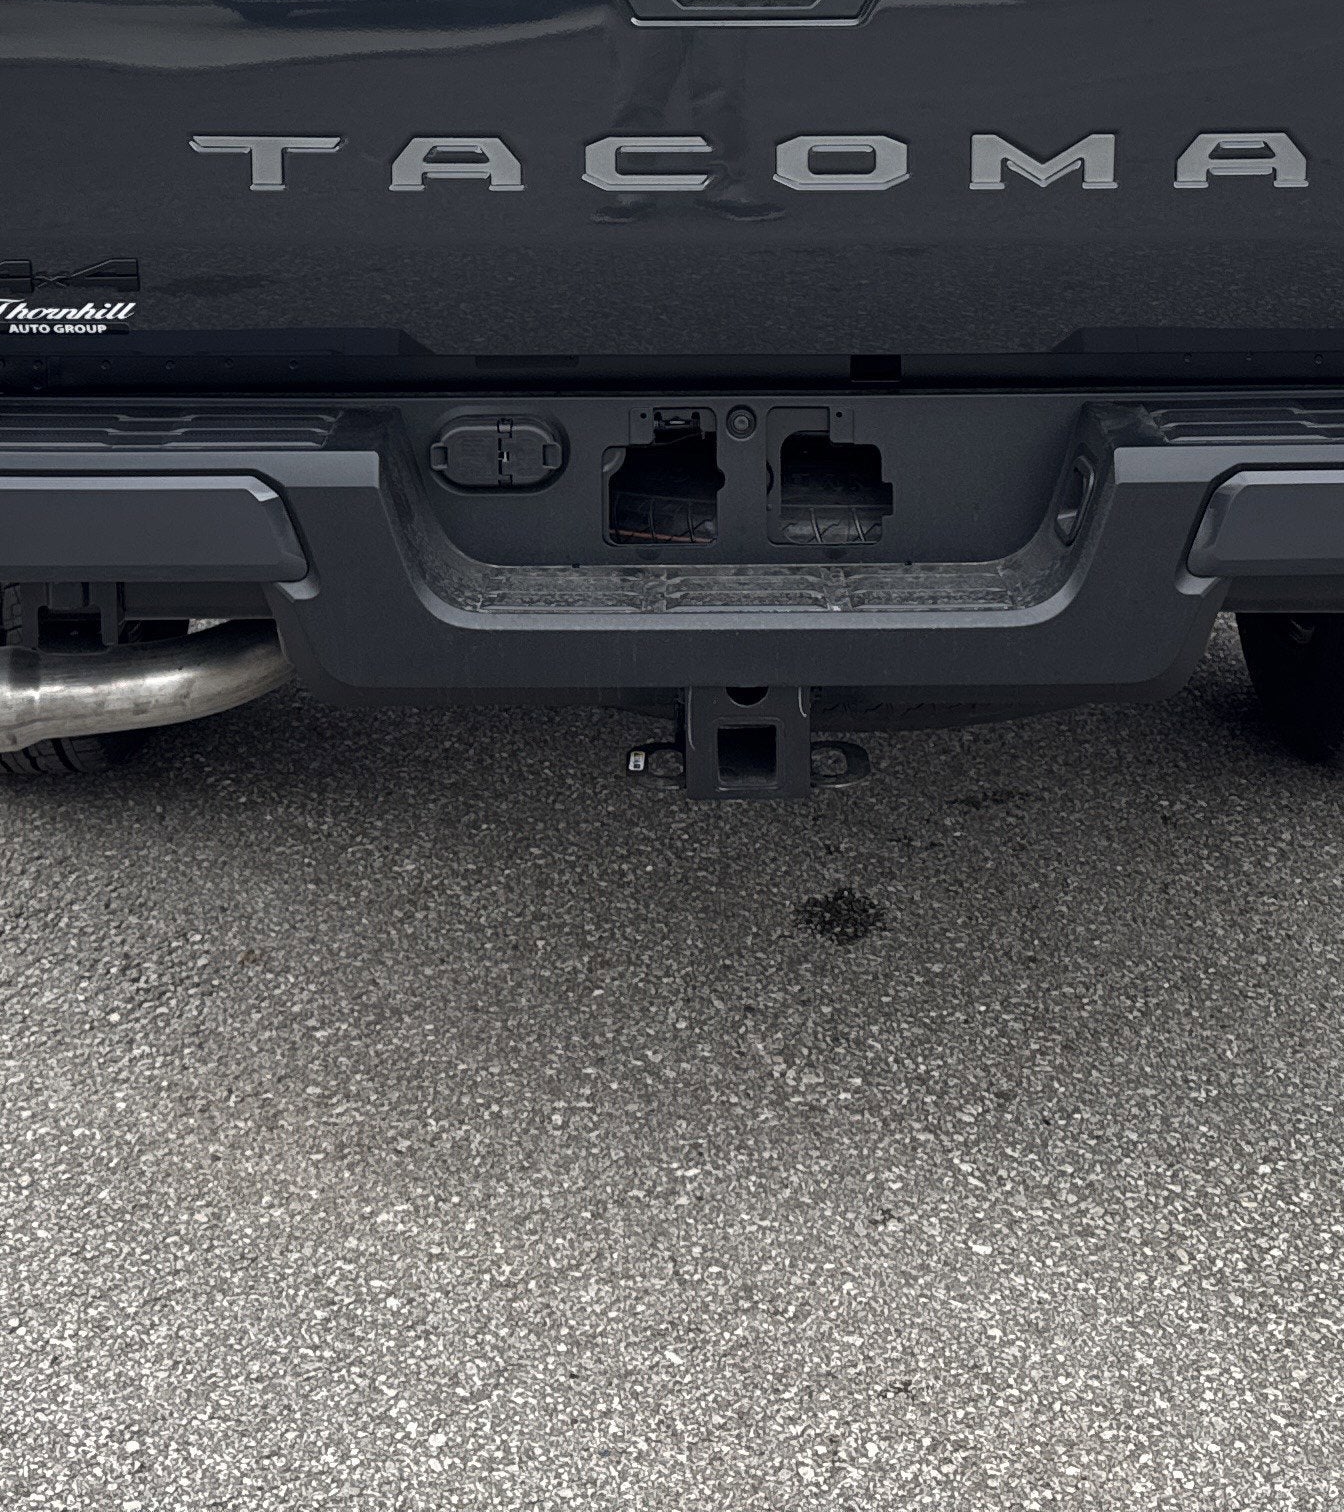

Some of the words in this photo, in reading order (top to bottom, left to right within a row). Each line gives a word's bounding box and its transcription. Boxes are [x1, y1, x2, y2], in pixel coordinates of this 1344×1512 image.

[189, 132, 1309, 192] TACOMA
[8, 324, 51, 334] AUTO
[53, 324, 108, 334] GROUP
